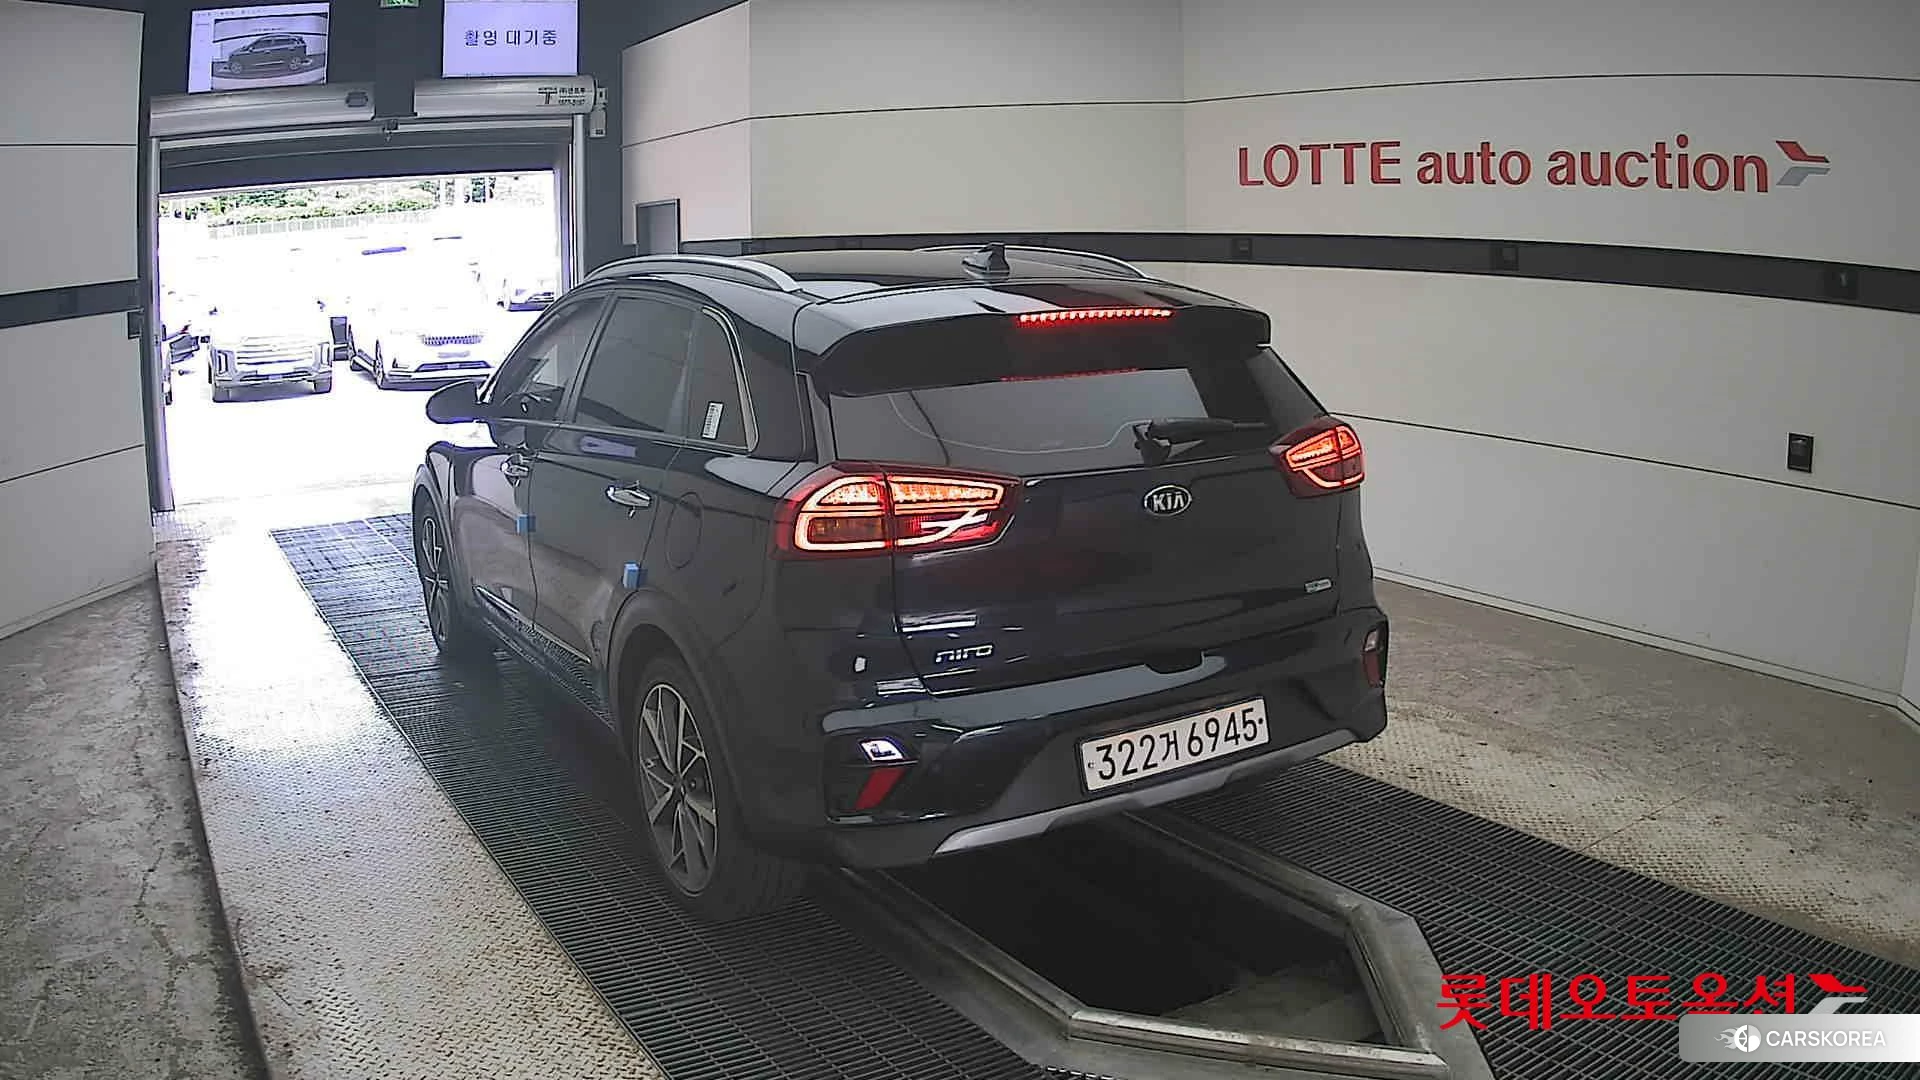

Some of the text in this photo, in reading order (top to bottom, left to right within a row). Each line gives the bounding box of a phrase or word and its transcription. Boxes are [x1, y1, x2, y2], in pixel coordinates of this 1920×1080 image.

[506, 29, 558, 46] 대기중
[1239, 134, 1769, 193] LOTTE auto auction
[1153, 491, 1185, 512] KIA
